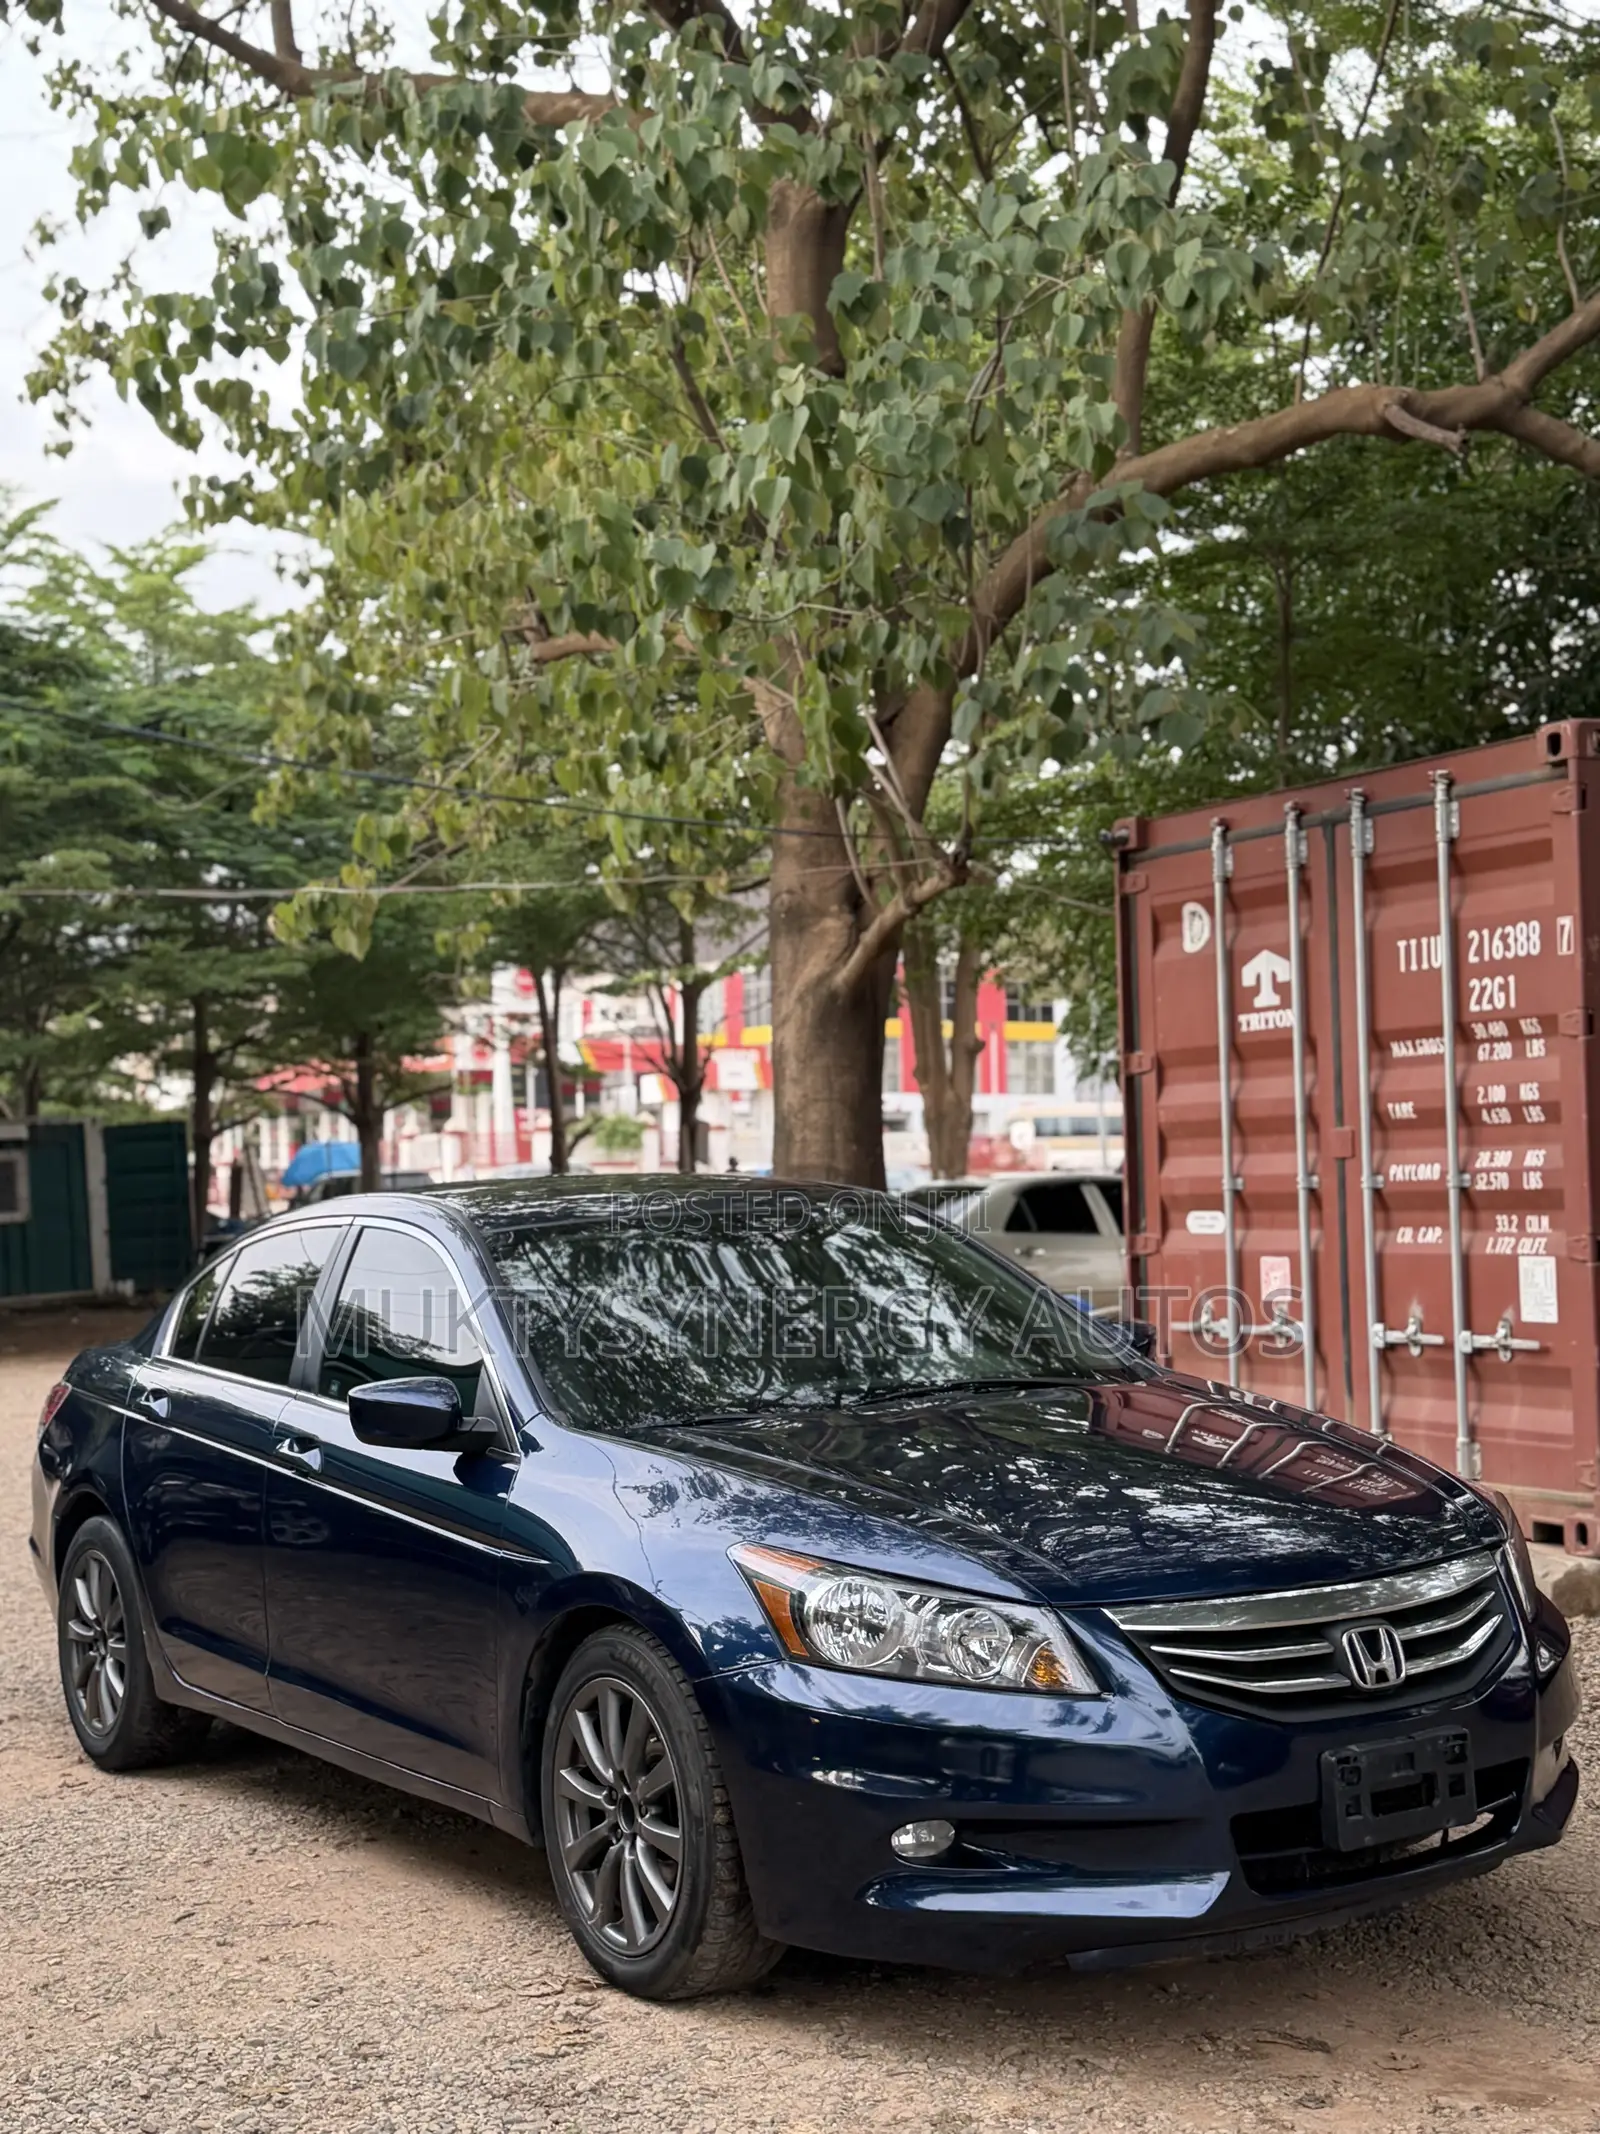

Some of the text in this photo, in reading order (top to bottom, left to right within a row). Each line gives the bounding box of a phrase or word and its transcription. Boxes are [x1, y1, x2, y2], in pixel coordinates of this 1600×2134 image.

[1397, 916, 1573, 973] TIIU 216388 7
[1468, 974, 1517, 1012] 22G1
[1477, 1038, 1546, 1062] 67.200 LBS
[1519, 1082, 1540, 1101] KGS
[1522, 1105, 1546, 1124] LBS
[1389, 1162, 1441, 1182] PAYLOAD
[1522, 1171, 1544, 1190] LBS
[1495, 1214, 1519, 1233] 33.2
[1417, 1226, 1443, 1244] CAP.
